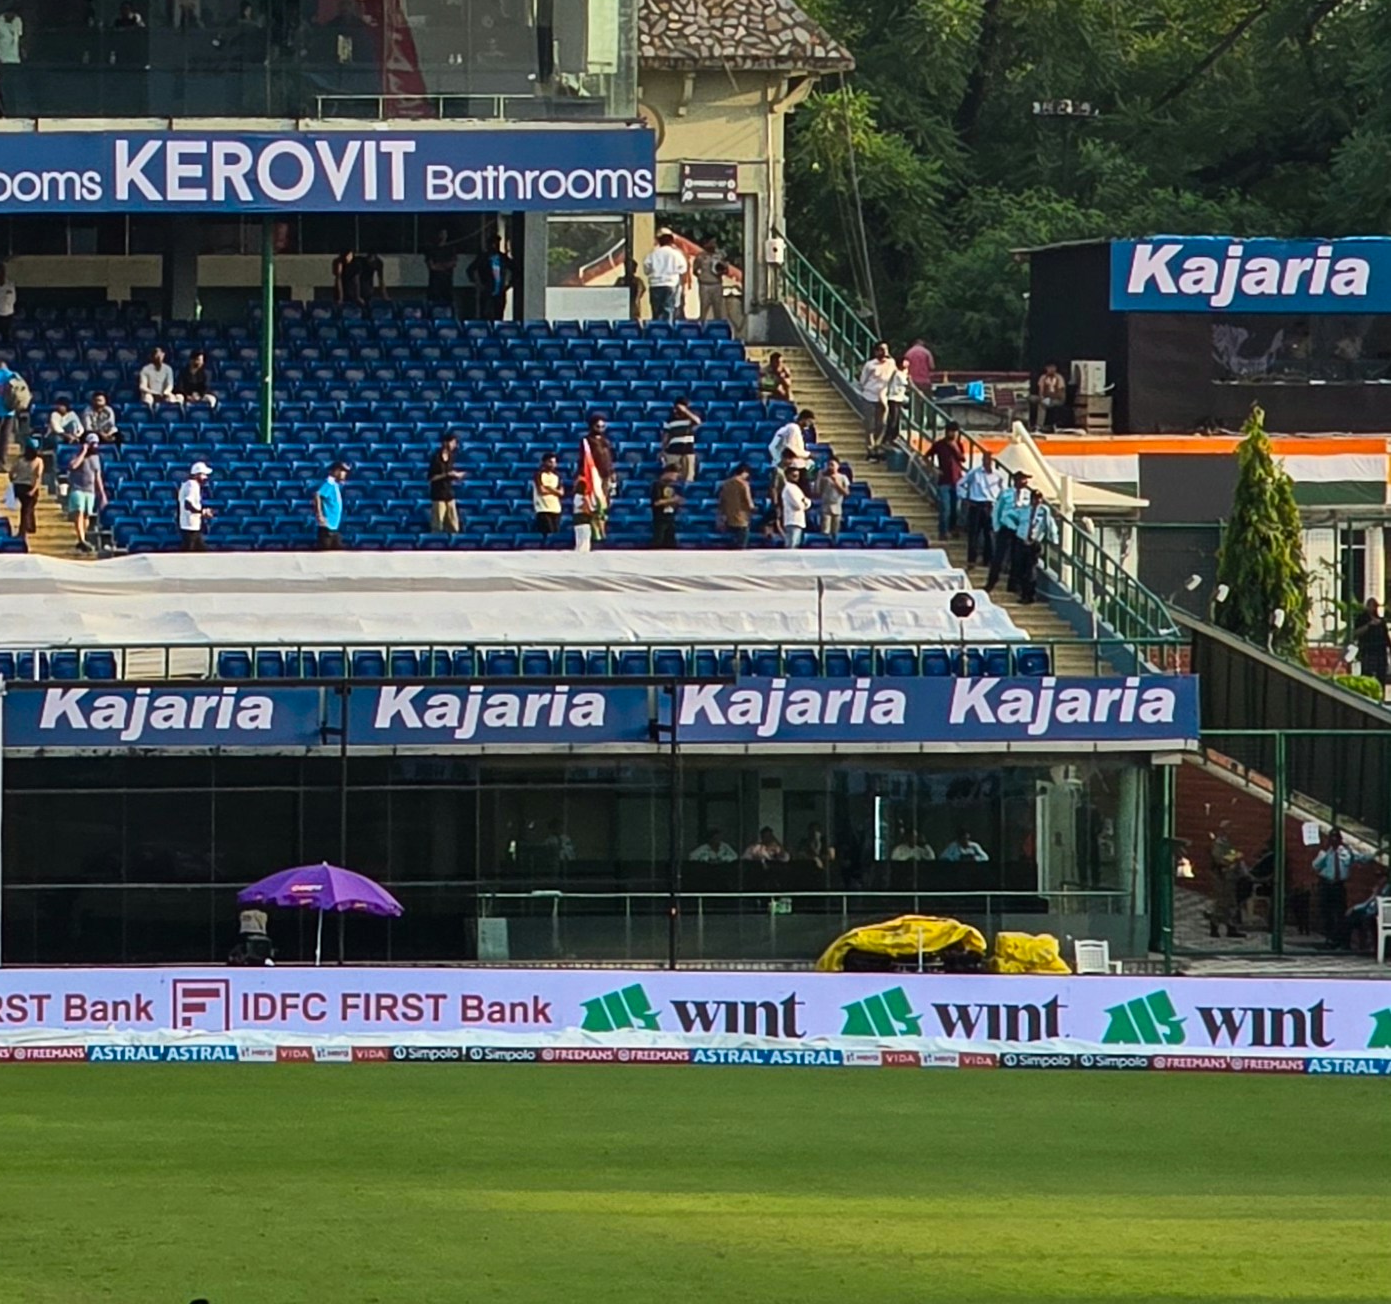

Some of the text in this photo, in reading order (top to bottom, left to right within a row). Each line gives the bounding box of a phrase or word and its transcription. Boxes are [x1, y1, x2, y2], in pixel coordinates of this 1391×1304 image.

[114, 139, 653, 202] KEROVIT Bathrooms
[1127, 244, 1371, 308] Kajaria
[374, 685, 606, 739] Kajaria
[678, 678, 906, 737] Kajaria
[949, 677, 1176, 735] Kajaria
[39, 687, 273, 741] Kajaria
[64, 993, 153, 1022] Bank
[242, 992, 552, 1023] IDFC FIRST Bank
[27, 1048, 84, 1059] FREEMANS
[91, 1046, 158, 1061] ASTRAL
[167, 1046, 235, 1061] ASTRAL
[280, 1049, 309, 1058] VIDA
[356, 1049, 385, 1059] VIDA
[408, 1047, 459, 1061] Simpolo
[484, 1048, 536, 1062] Simpolo
[555, 1049, 613, 1061] FREEMANS
[631, 1049, 689, 1062] FREEMANS
[694, 1050, 763, 1064] ASTRAL
[770, 1050, 839, 1065] ASTRAL
[886, 1054, 915, 1063] VIDA
[963, 1056, 993, 1066] VIDA
[1020, 1053, 1071, 1069] Simpolo
[1096, 1054, 1148, 1069] Simpolo
[1167, 1057, 1226, 1069] FREEMANS
[1244, 1058, 1304, 1071] FREEMANS
[1309, 1059, 1378, 1074] ASTRAL
